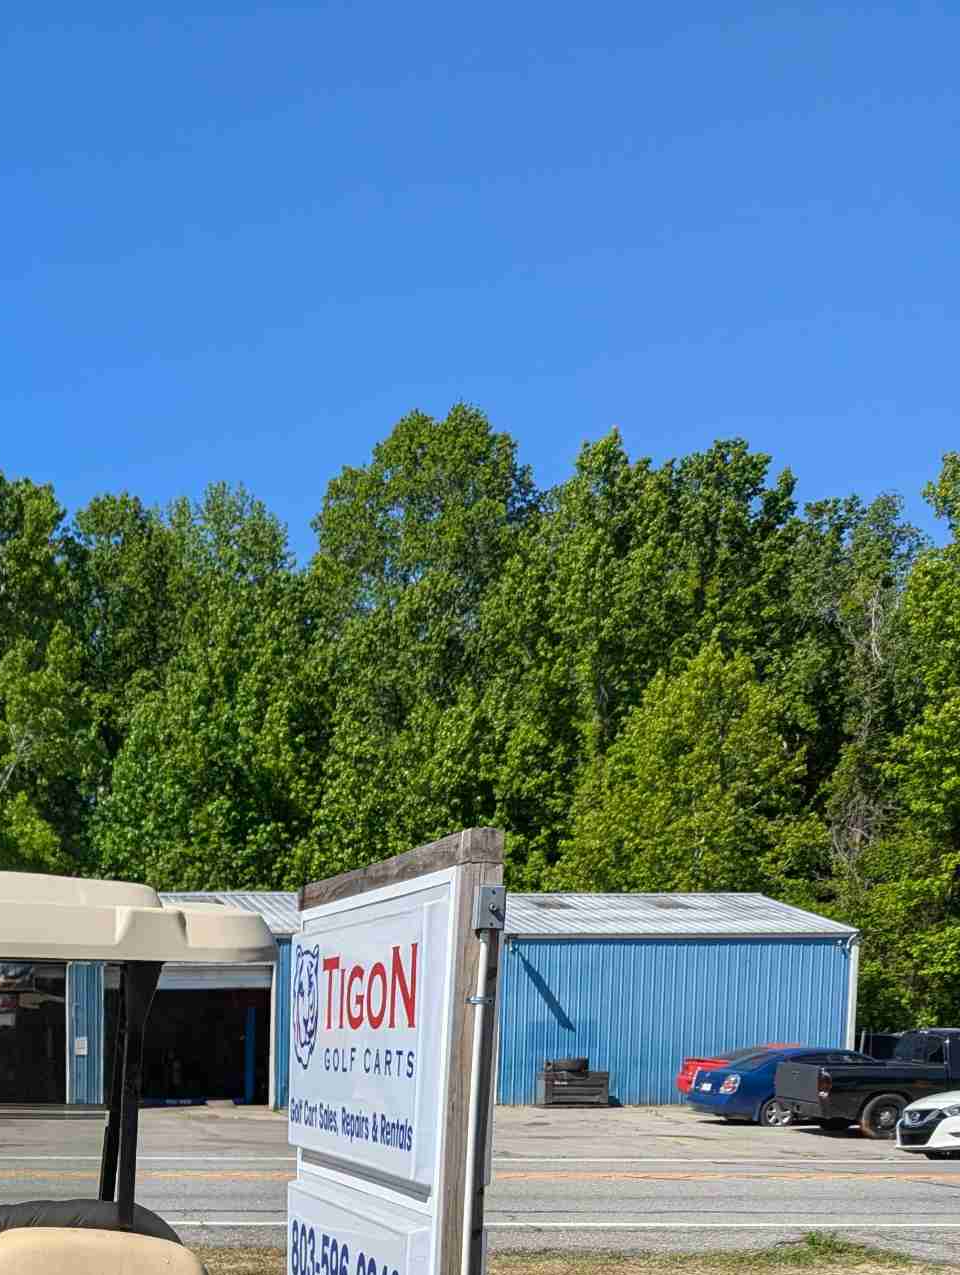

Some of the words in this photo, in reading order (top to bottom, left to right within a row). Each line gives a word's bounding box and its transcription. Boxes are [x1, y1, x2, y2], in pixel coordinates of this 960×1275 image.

[323, 943, 419, 1030] TIGON
[324, 1048, 357, 1072] GOLF
[363, 1048, 415, 1079] CARTS
[290, 1098, 303, 1125] Golf
[304, 1099, 318, 1129] Cart
[319, 1102, 339, 1136] Sales,
[341, 1106, 369, 1142] Repairs
[372, 1111, 378, 1143] &
[380, 1113, 413, 1152] Rentals
